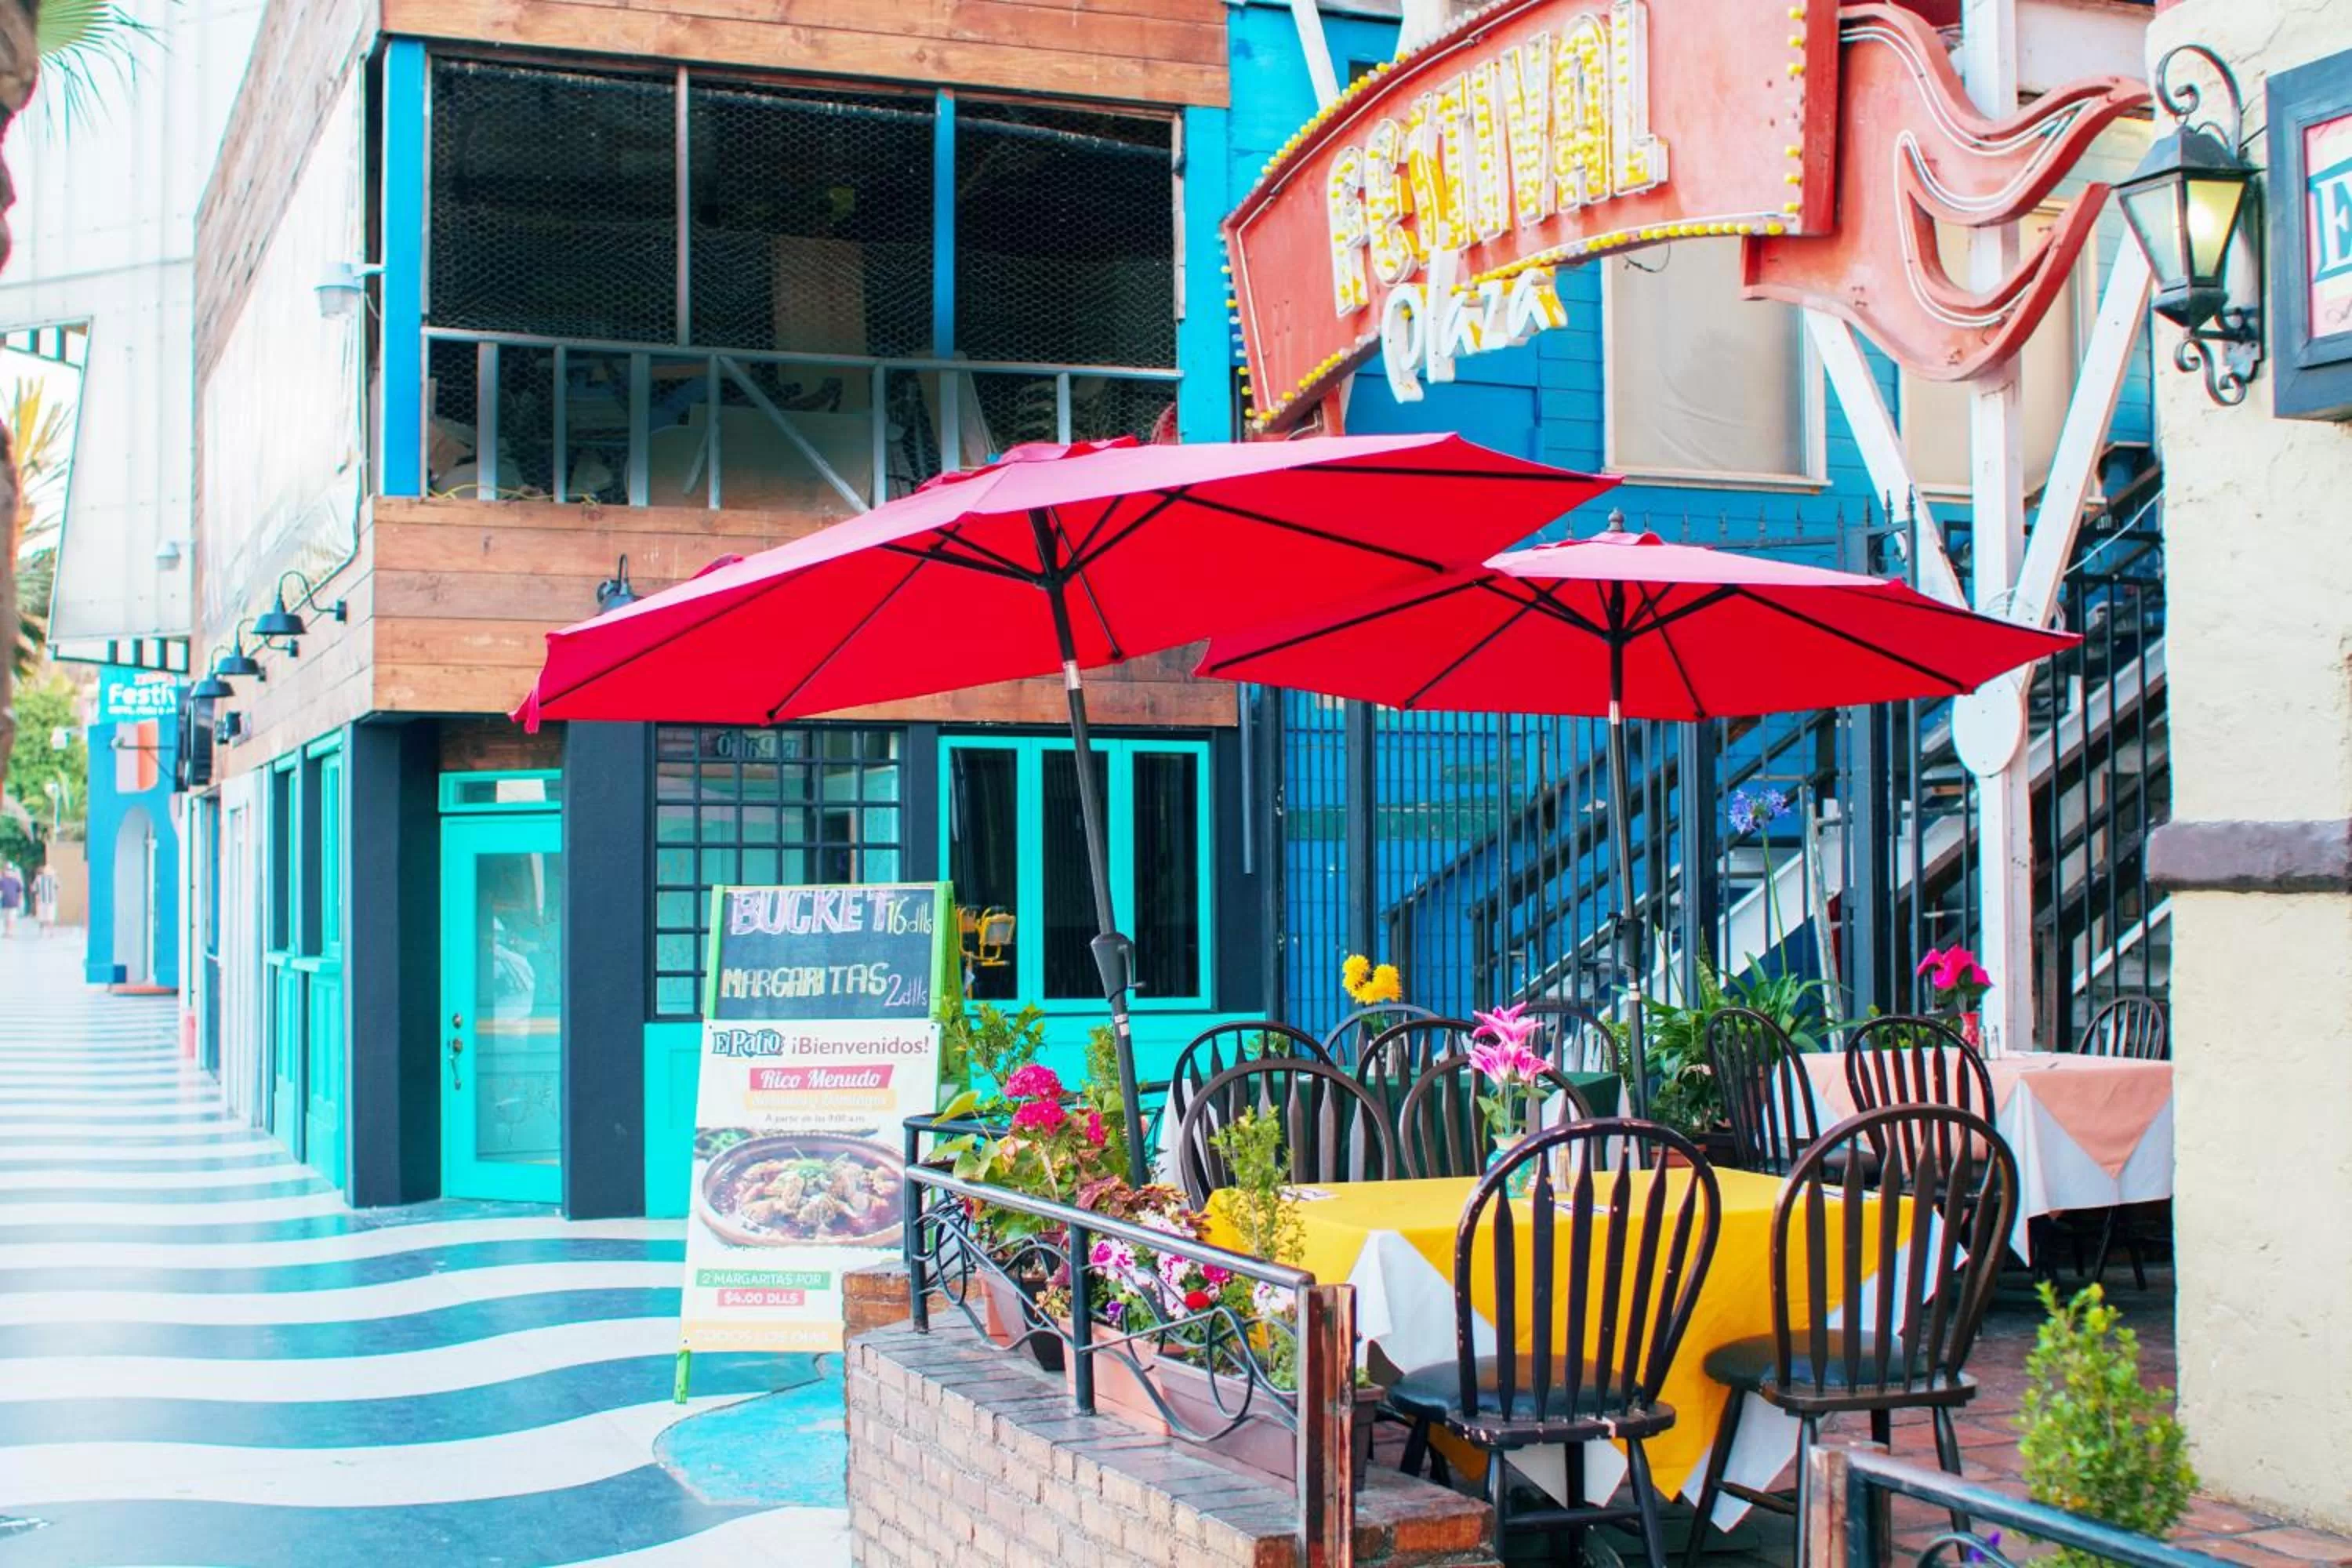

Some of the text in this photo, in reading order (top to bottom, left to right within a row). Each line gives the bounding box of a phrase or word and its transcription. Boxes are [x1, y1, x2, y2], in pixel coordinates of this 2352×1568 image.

[731, 889, 890, 935] BUCKET
[720, 963, 890, 999] MARGARITAS
[728, 1029, 784, 1057] Patio
[792, 1036, 929, 1055] ¡Bienvenidos!
[760, 1066, 880, 1091] Rico Menudo
[702, 1272, 710, 1284] 2
[713, 1272, 793, 1286] MARGARITAS
[724, 1292, 799, 1305] $4.00 DLLS
